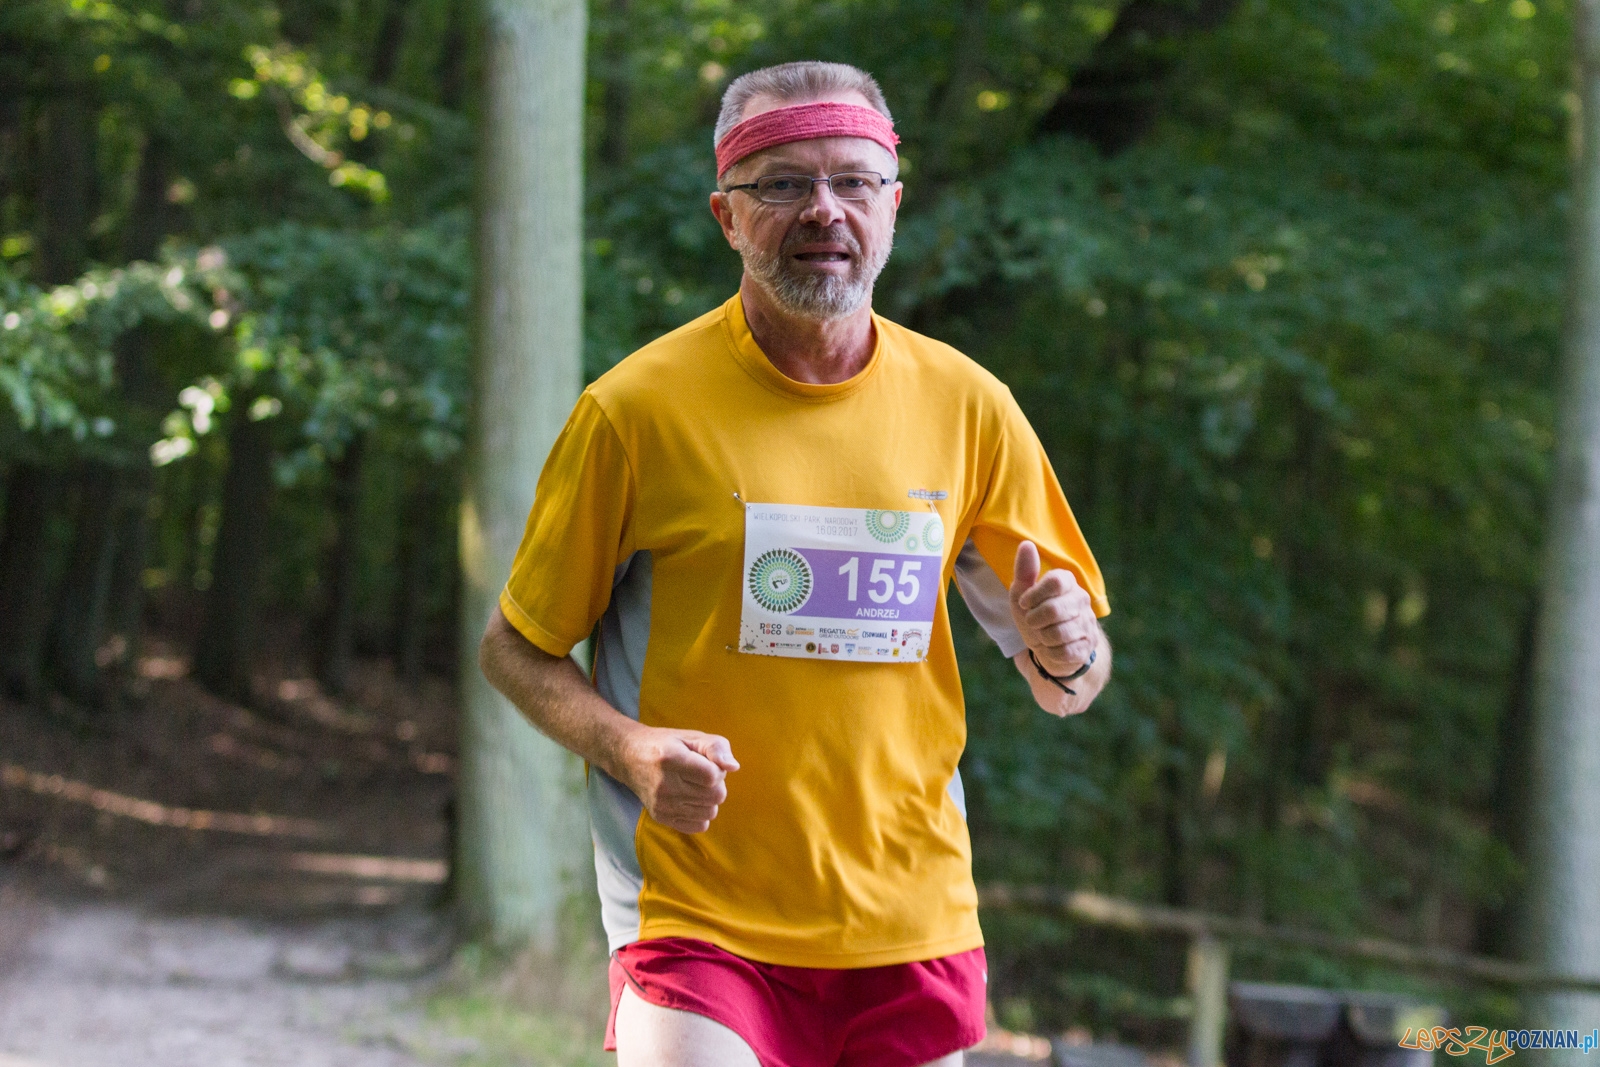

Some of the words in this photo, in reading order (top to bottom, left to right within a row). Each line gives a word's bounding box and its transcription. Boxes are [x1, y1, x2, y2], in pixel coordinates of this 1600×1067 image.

[804, 515, 821, 524] PARK
[838, 556, 922, 605] 155
[855, 607, 900, 619] ANDRZEJ
[819, 627, 846, 635] REGATTA
